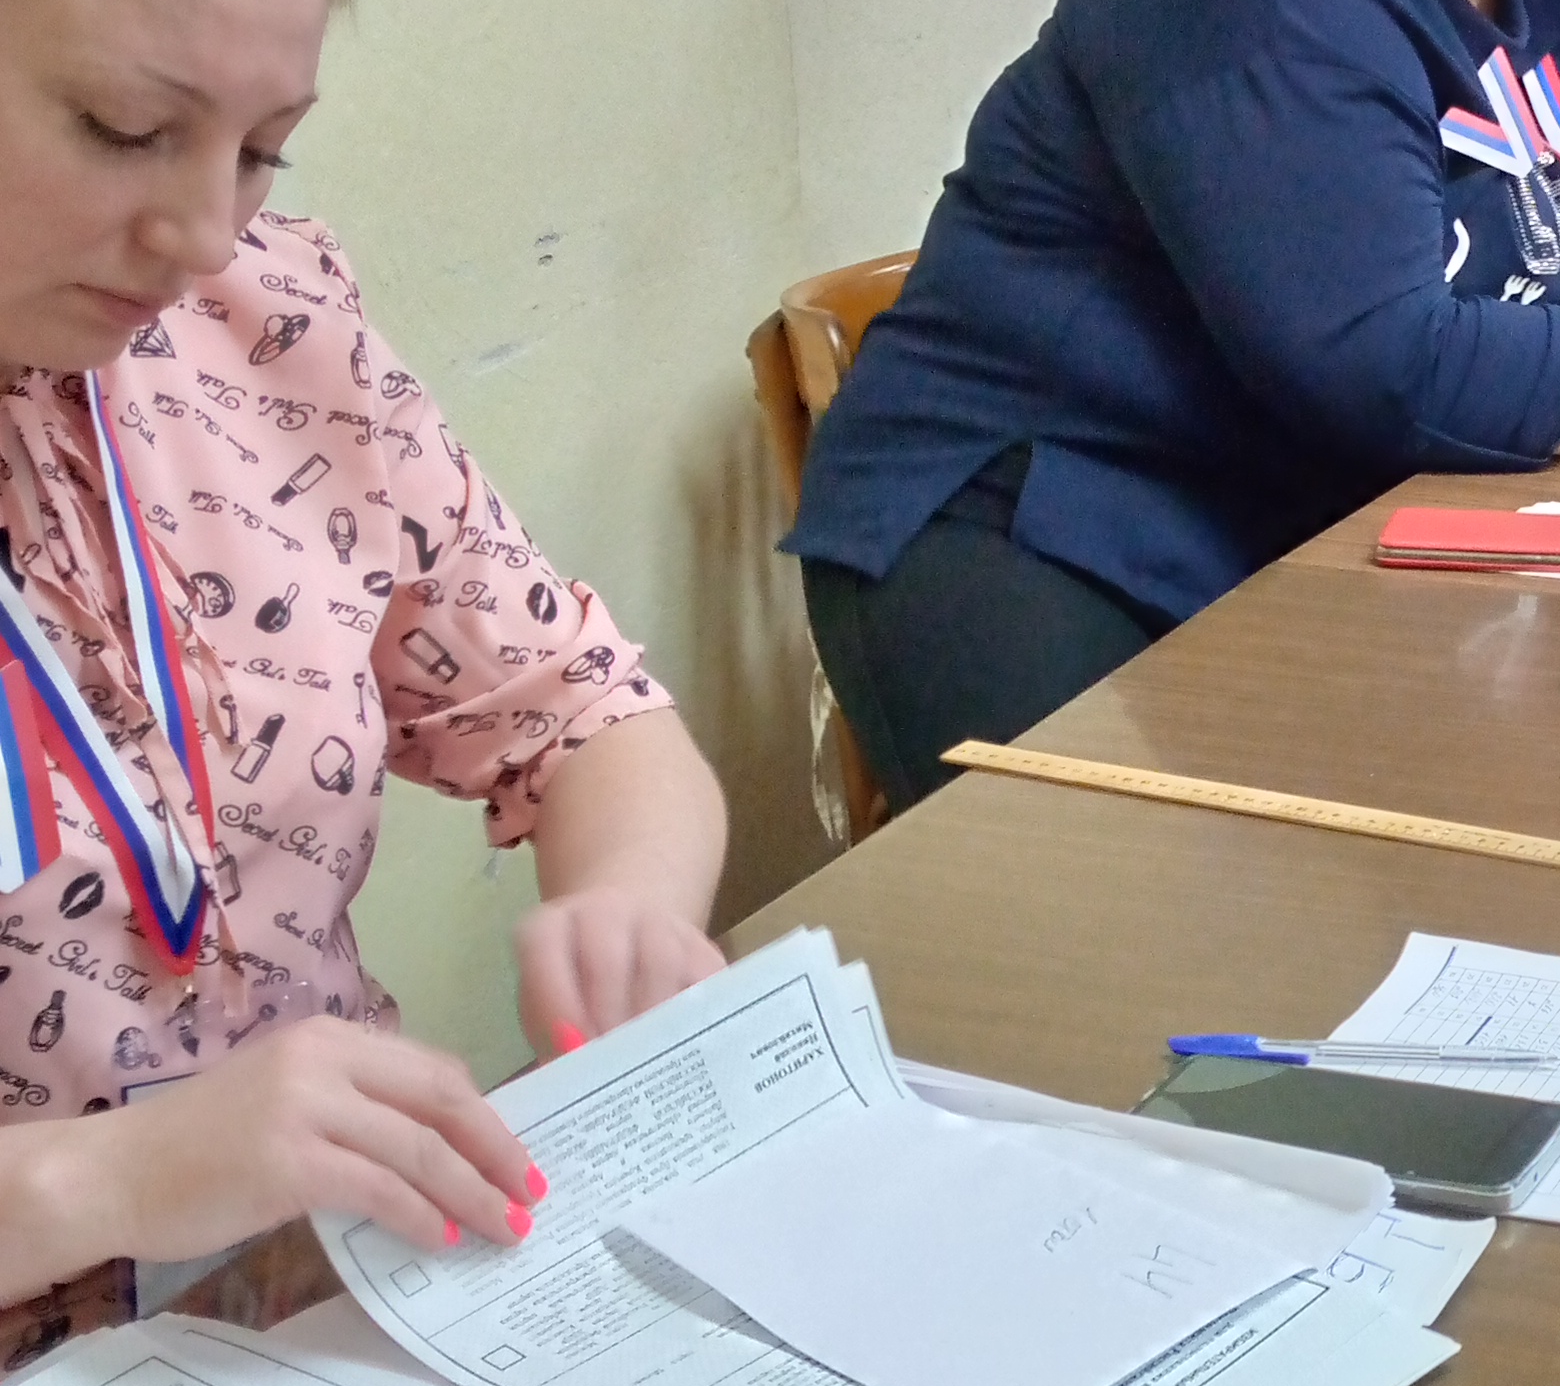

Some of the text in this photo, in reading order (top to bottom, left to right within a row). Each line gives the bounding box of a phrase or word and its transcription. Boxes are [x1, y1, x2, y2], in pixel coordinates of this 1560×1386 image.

[326, 599, 378, 633] Talk
[290, 667, 332, 693] Talk
[218, 803, 280, 843] Secret
